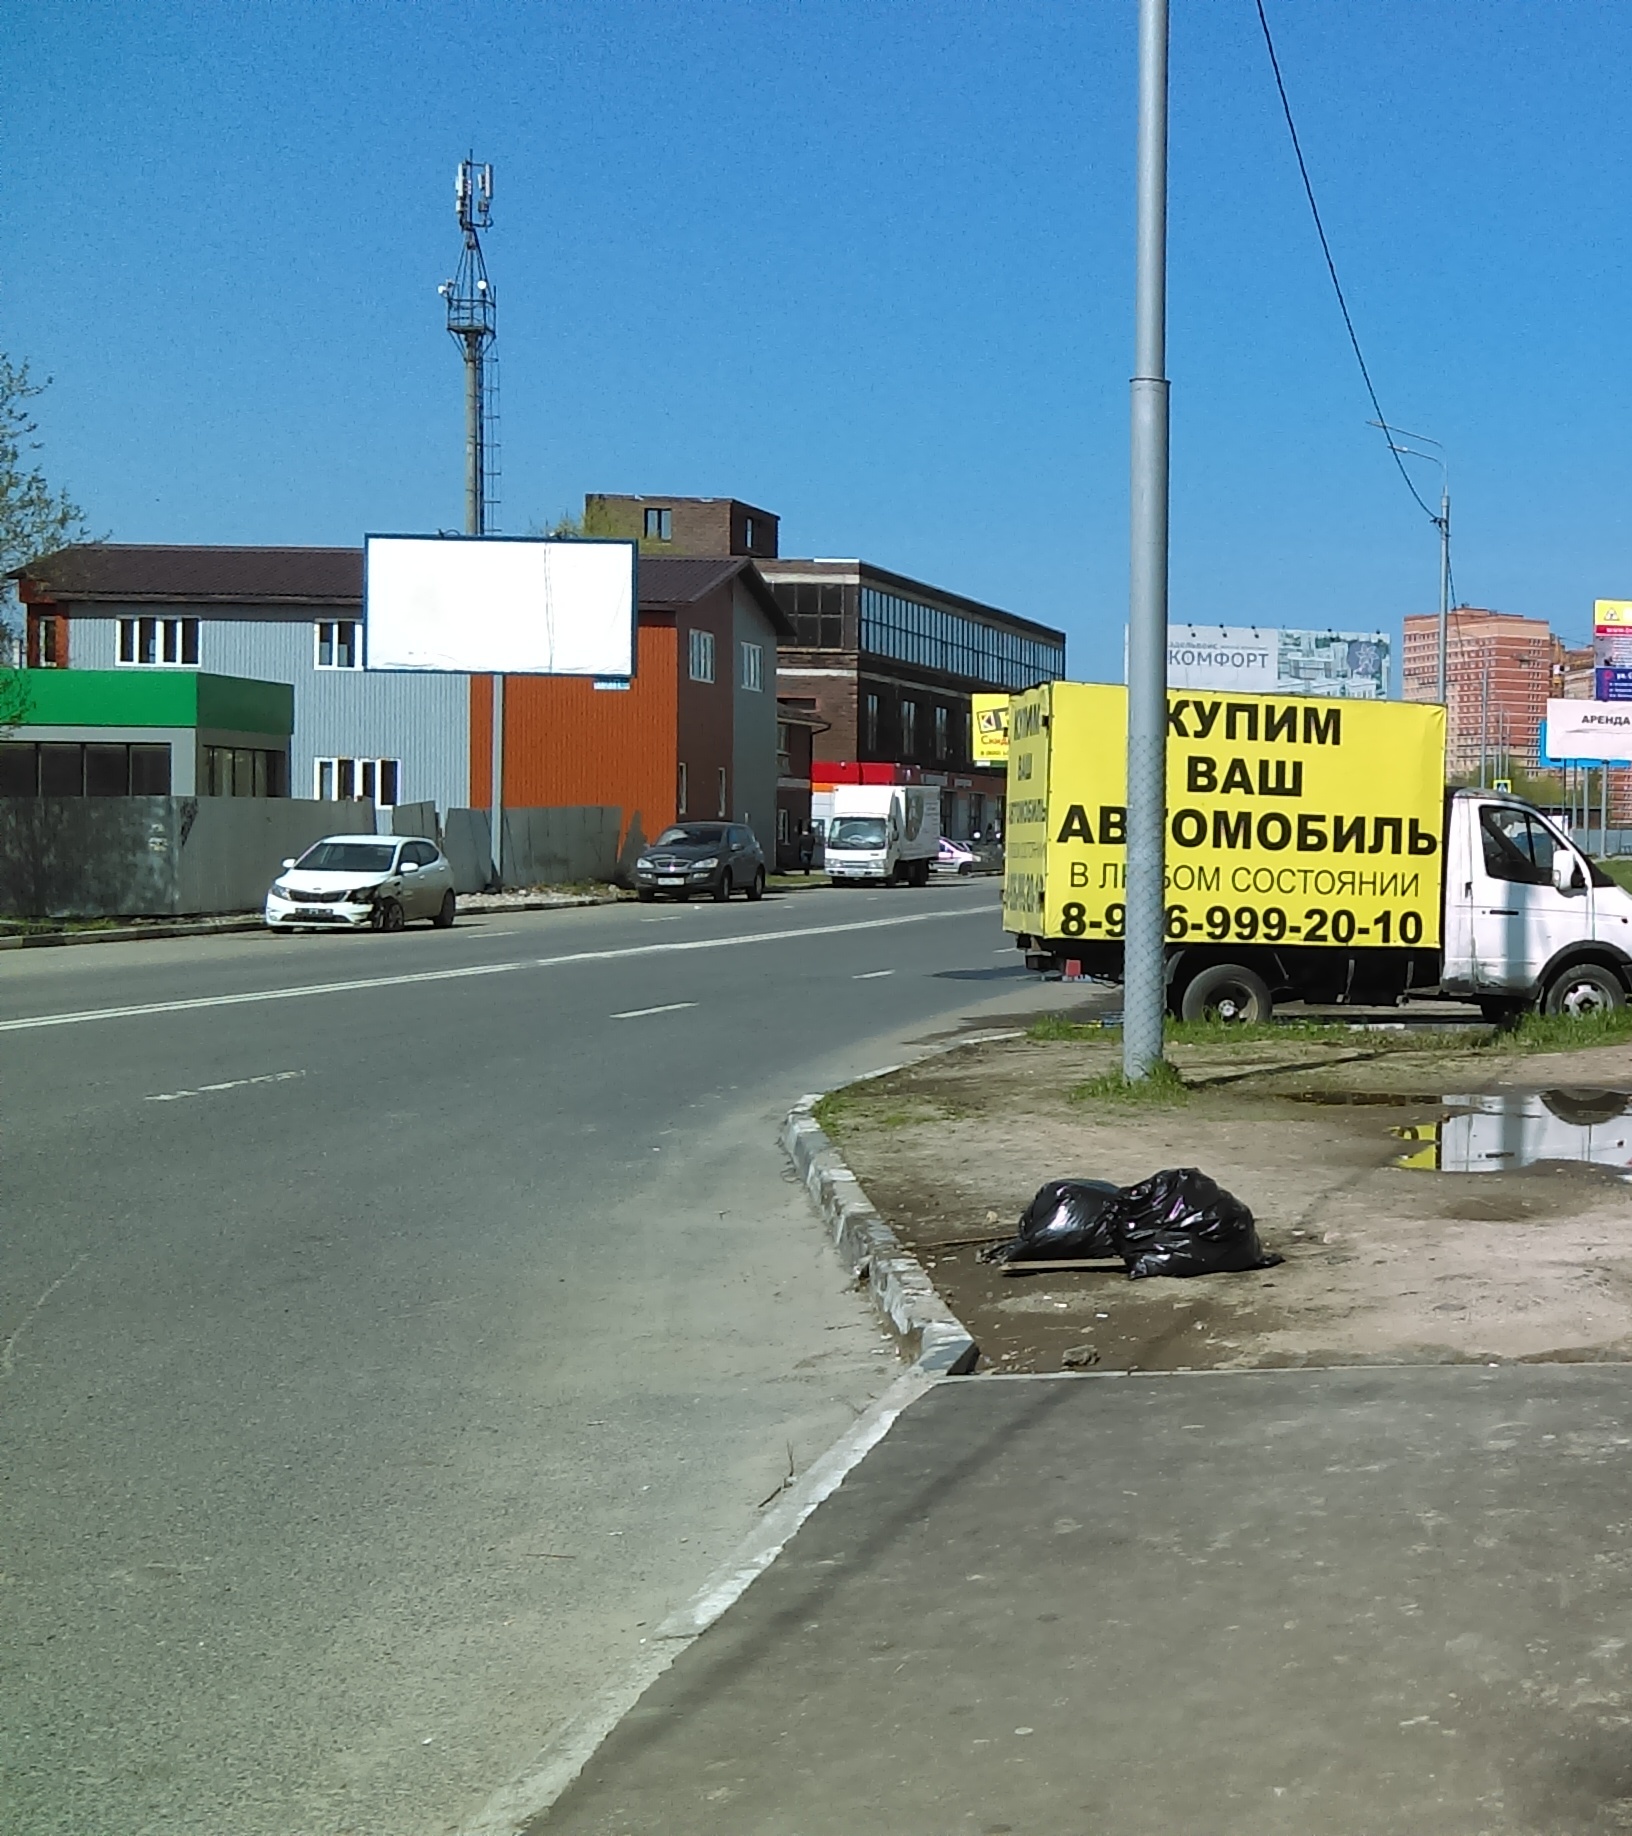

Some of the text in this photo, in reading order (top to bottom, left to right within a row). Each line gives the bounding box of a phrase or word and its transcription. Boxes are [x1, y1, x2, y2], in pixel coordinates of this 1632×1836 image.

[1169, 650, 1269, 669] КОМФОРТ
[1166, 699, 1342, 747] КУПИМ
[1581, 714, 1631, 727] АРЕНДА
[1187, 756, 1303, 798] ВАШ
[1057, 804, 1439, 857] АВОМОБИЛЬ
[1070, 862, 1420, 898] В ЛОМ СОСТОЯНИИ
[1060, 902, 1424, 944] 8-96-999-20-10
